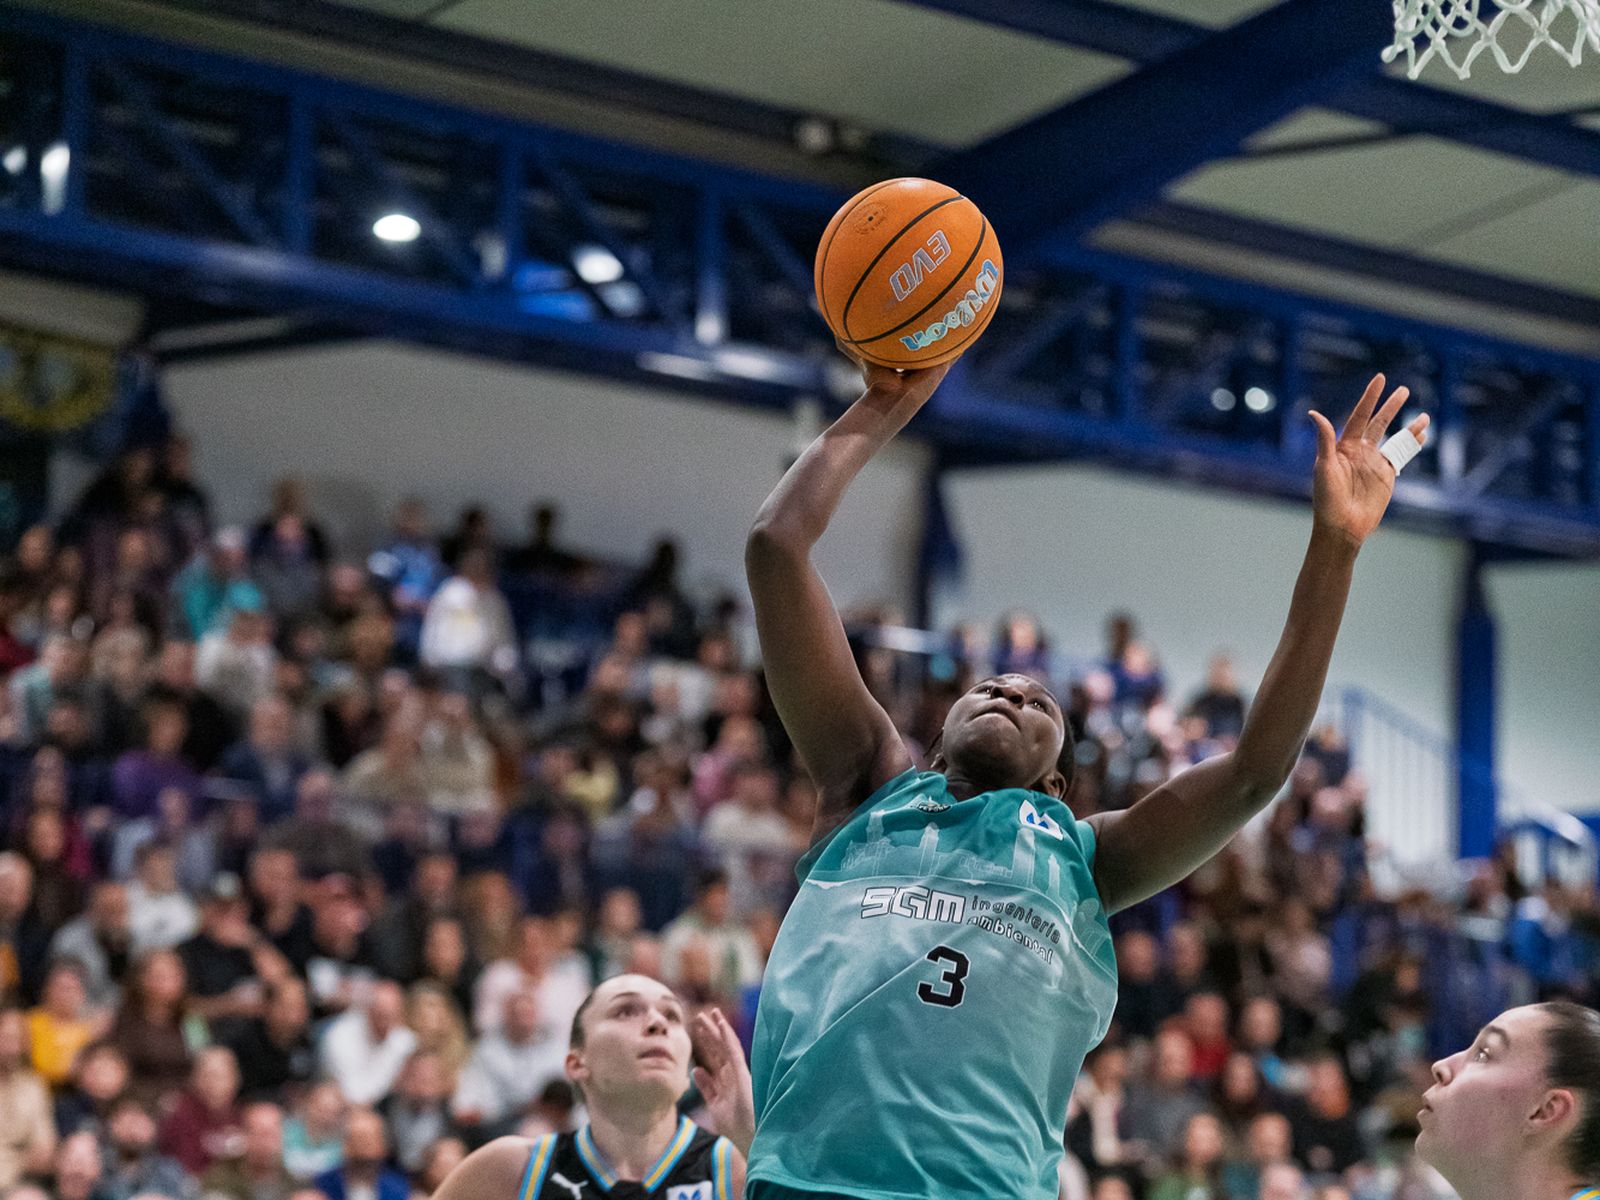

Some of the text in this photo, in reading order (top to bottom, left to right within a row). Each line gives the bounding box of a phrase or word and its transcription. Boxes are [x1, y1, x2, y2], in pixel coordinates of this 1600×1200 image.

[888, 229, 952, 302] EVO
[900, 258, 1000, 351] Wilson
[861, 885, 967, 925] SGM
[967, 915, 1054, 965] ambiental
[916, 944, 971, 1009] 3
